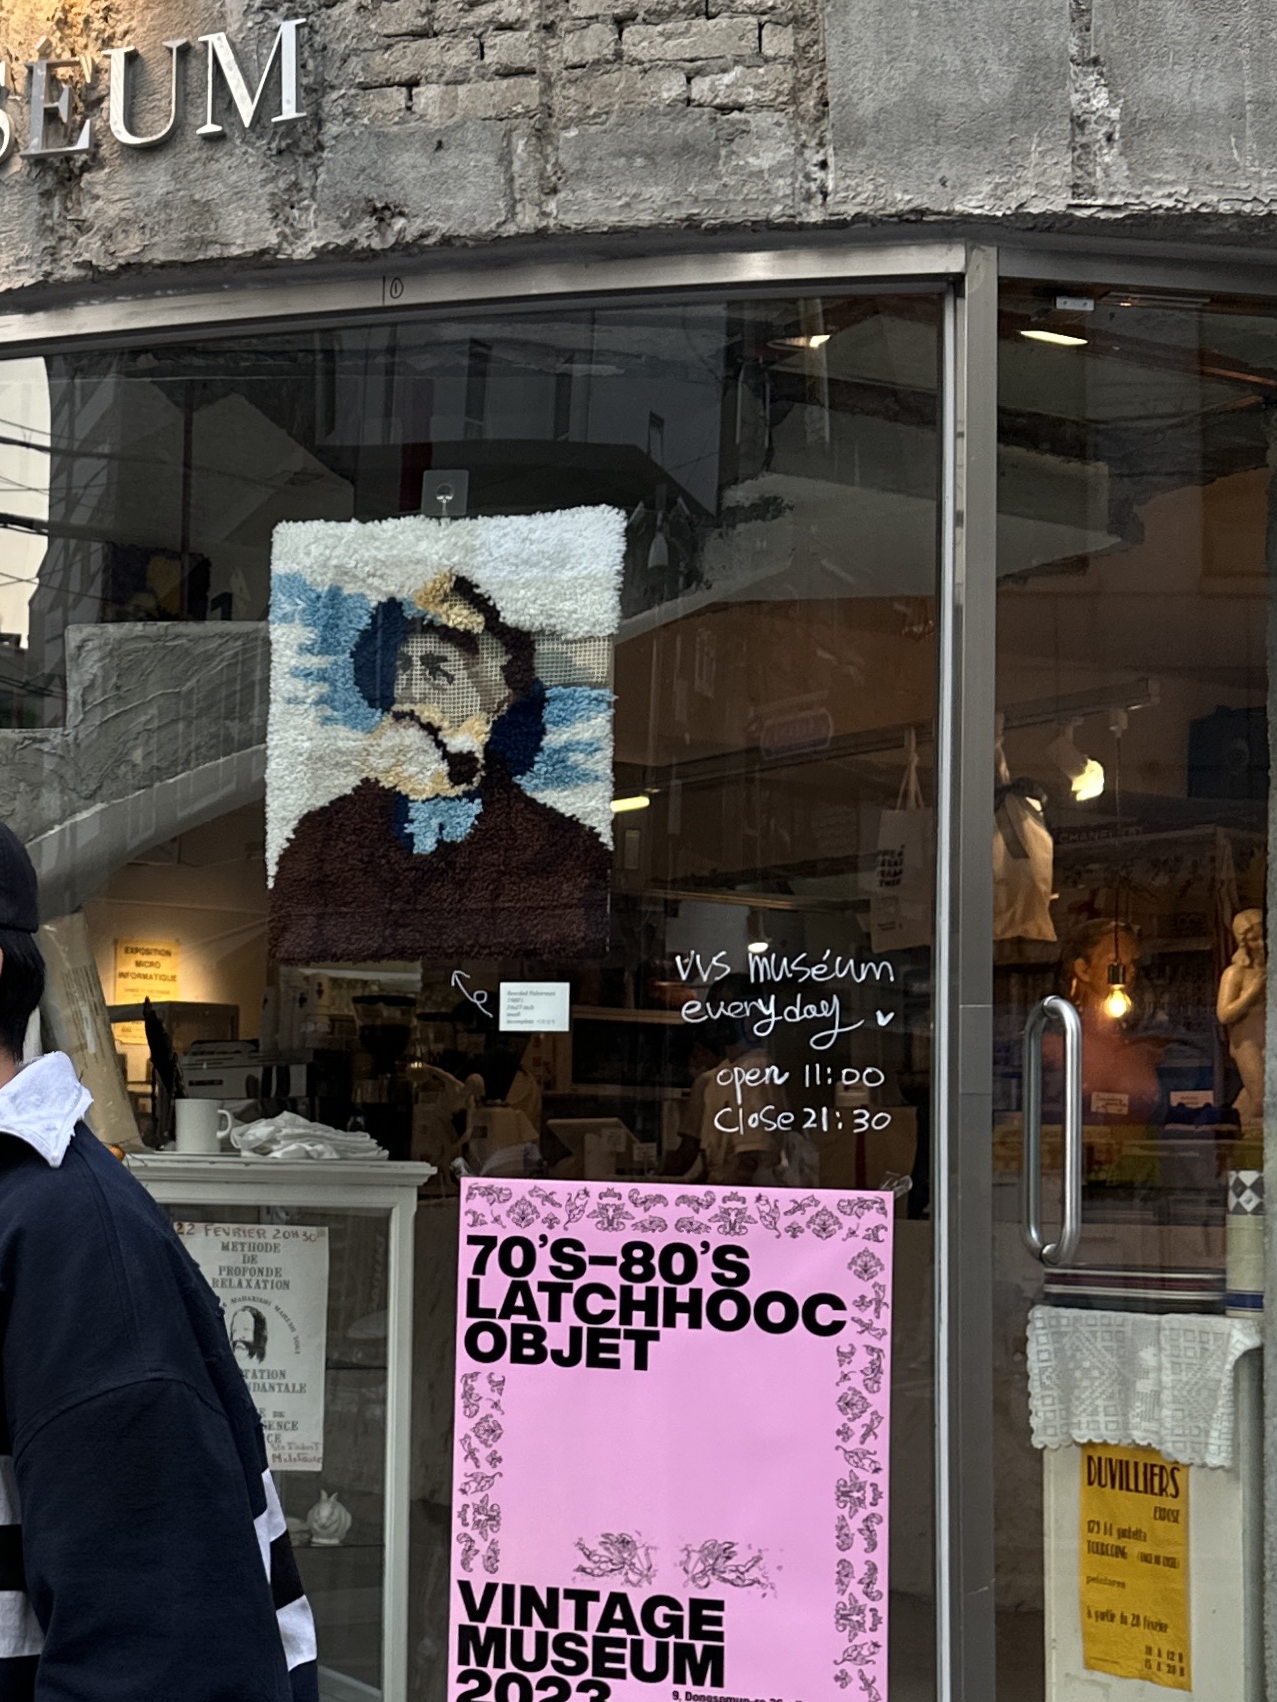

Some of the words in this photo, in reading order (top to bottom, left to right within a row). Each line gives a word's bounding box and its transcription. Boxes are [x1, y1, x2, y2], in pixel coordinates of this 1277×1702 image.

[124, 946, 172, 957] EXPOSITION
[135, 960, 161, 969] MICRO
[118, 971, 177, 982] INFORMATIQUE
[221, 1241, 281, 1253] METHODE
[242, 1254, 258, 1265] DE
[466, 1234, 751, 1288] 70'S-80'S
[218, 1265, 283, 1278] PROFONDE
[211, 1278, 290, 1290] RELAXATION
[465, 1278, 847, 1337] LATCHHOOC
[464, 1320, 660, 1371] OBJET
[1087, 1455, 1180, 1499] DUVILLIERS
[457, 1580, 724, 1643] VINTAGE
[457, 1624, 724, 1689] MUSEUM
